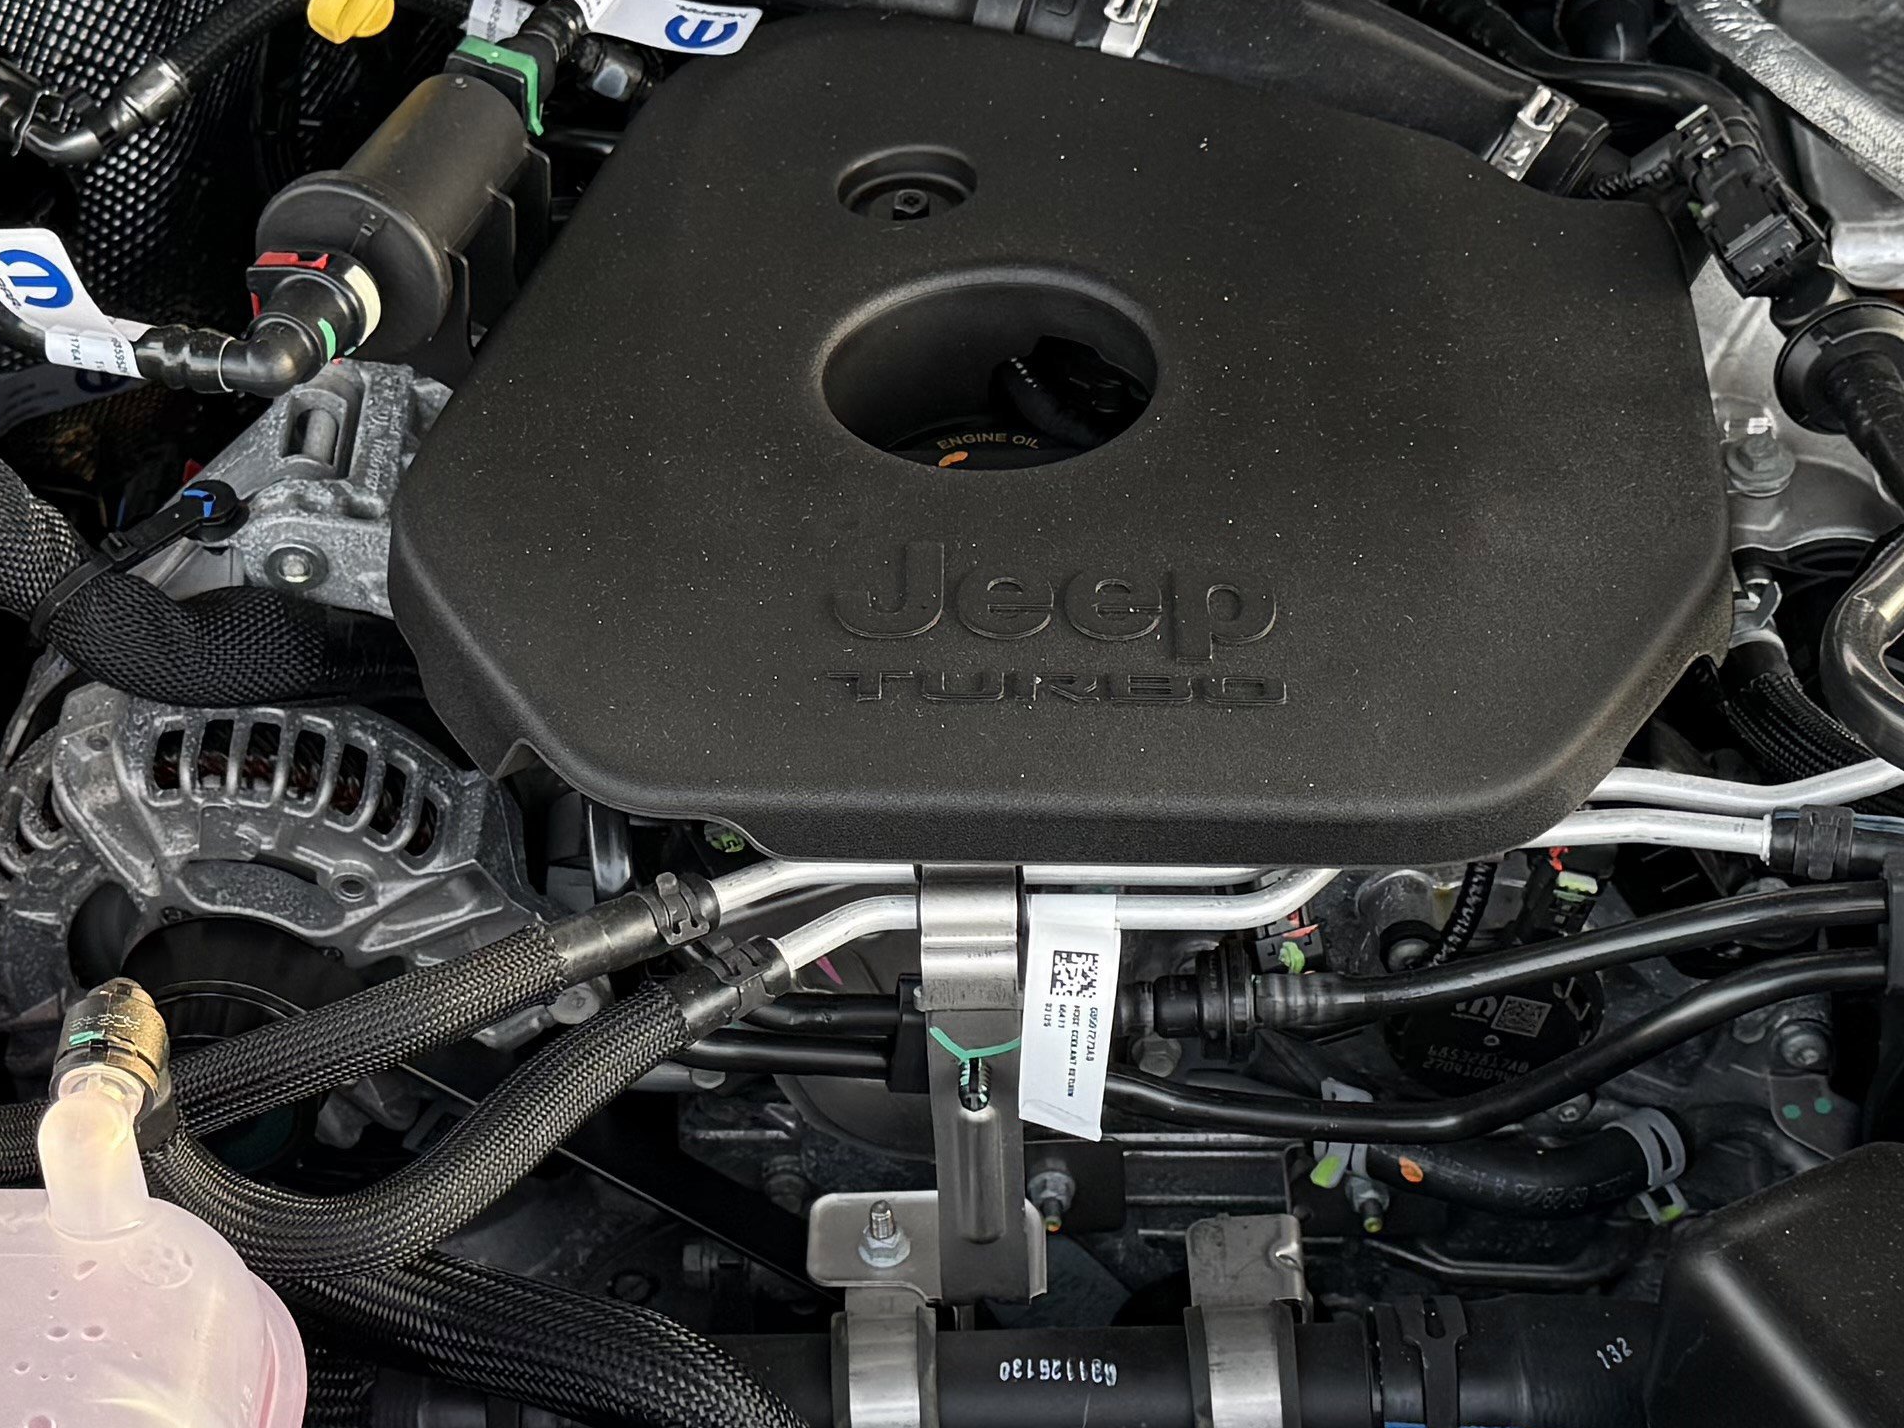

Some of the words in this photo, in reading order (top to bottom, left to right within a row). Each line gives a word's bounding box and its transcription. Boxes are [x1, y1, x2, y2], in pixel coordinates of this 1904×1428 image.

[936, 433, 1008, 450] ENGINE
[1012, 435, 1039, 449] OIL
[831, 540, 1279, 664] Jeep
[827, 667, 1290, 705] TURBO
[1596, 1336, 1633, 1370] 132
